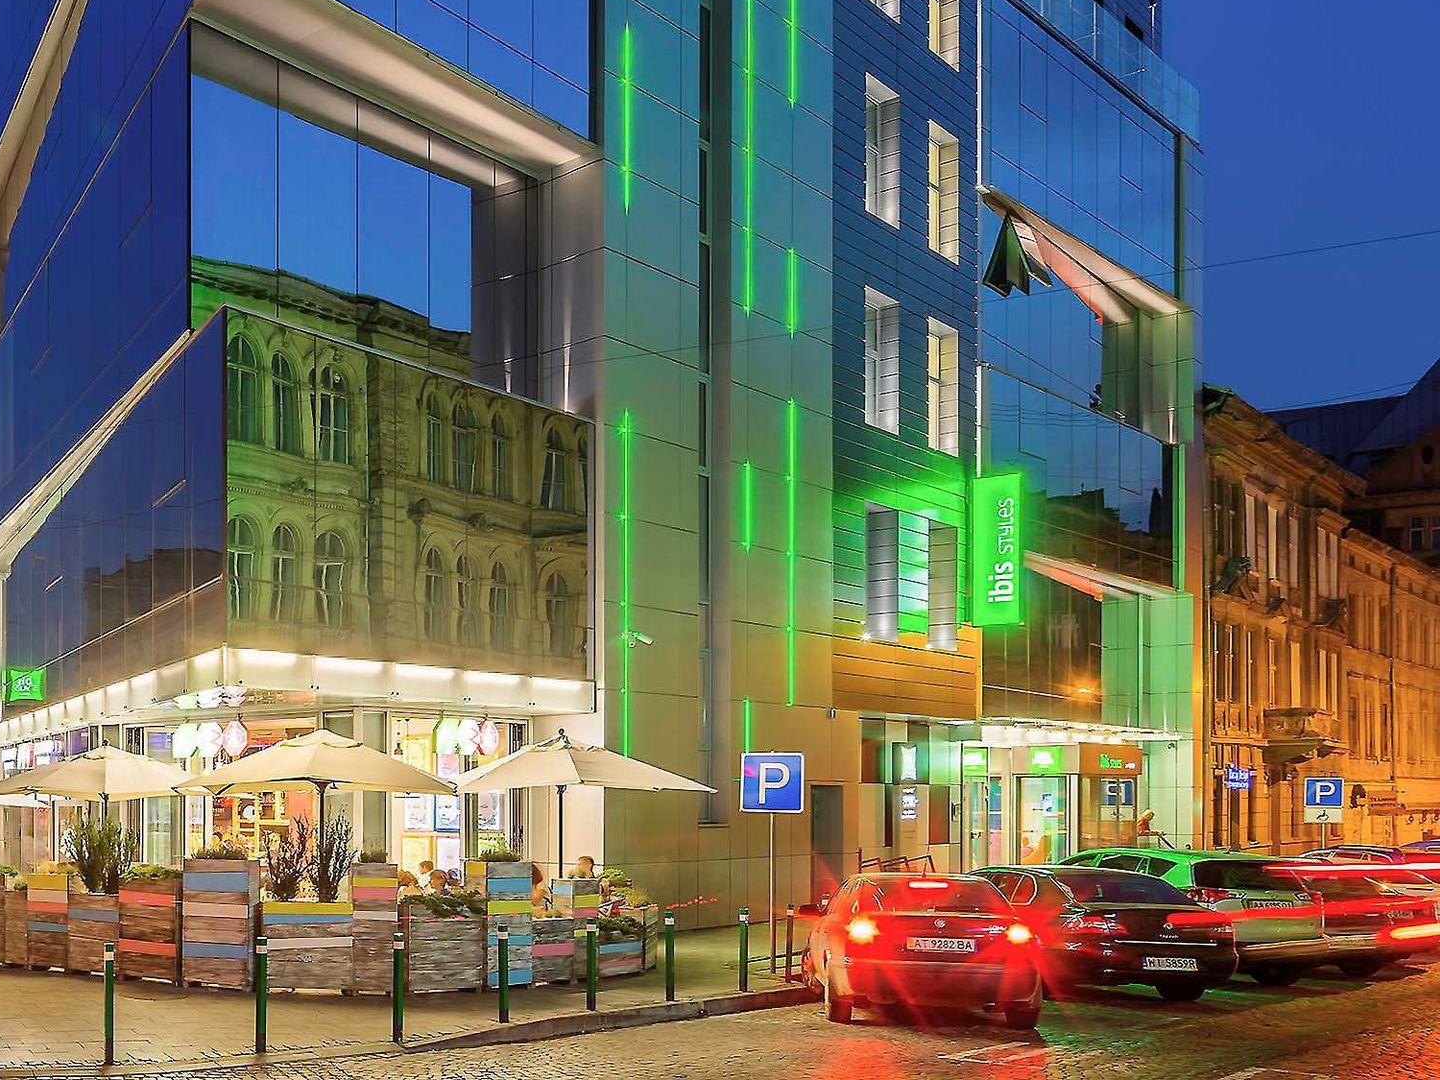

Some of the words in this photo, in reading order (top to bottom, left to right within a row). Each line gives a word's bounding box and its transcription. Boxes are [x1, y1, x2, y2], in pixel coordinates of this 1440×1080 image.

[987, 561, 1015, 603] ibis
[758, 762, 790, 805] P
[1314, 781, 1336, 804] P
[931, 939, 955, 949] 9282
[957, 940, 973, 950] BA
